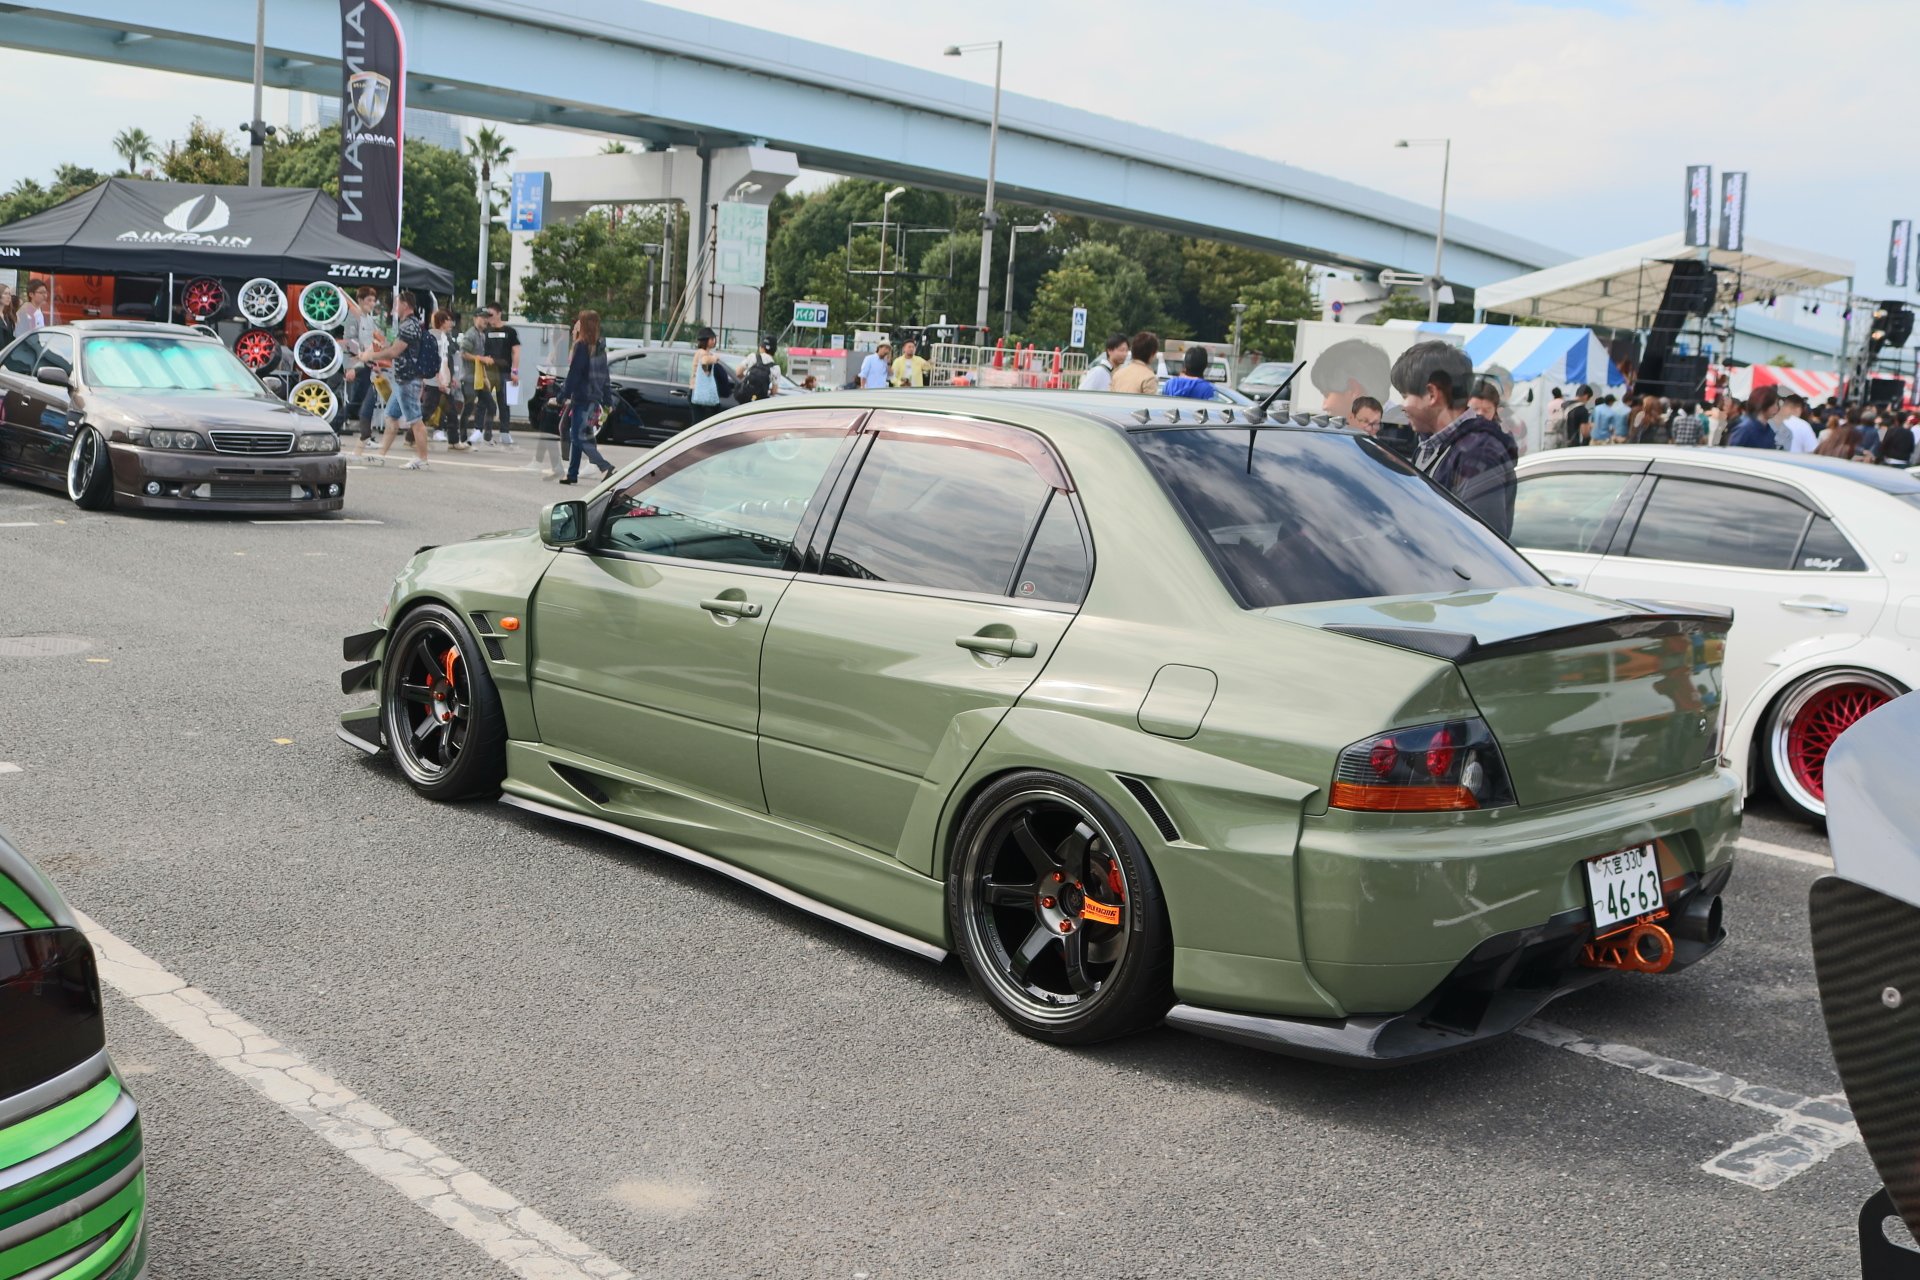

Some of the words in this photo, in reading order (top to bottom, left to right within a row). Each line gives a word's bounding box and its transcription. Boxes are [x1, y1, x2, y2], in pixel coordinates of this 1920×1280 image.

[117, 230, 252, 245] AIMGAIN
[796, 309, 815, 321] バイク
[817, 310, 825, 321] P
[1602, 855, 1622, 878] 大宮
[1624, 849, 1643, 871] 330
